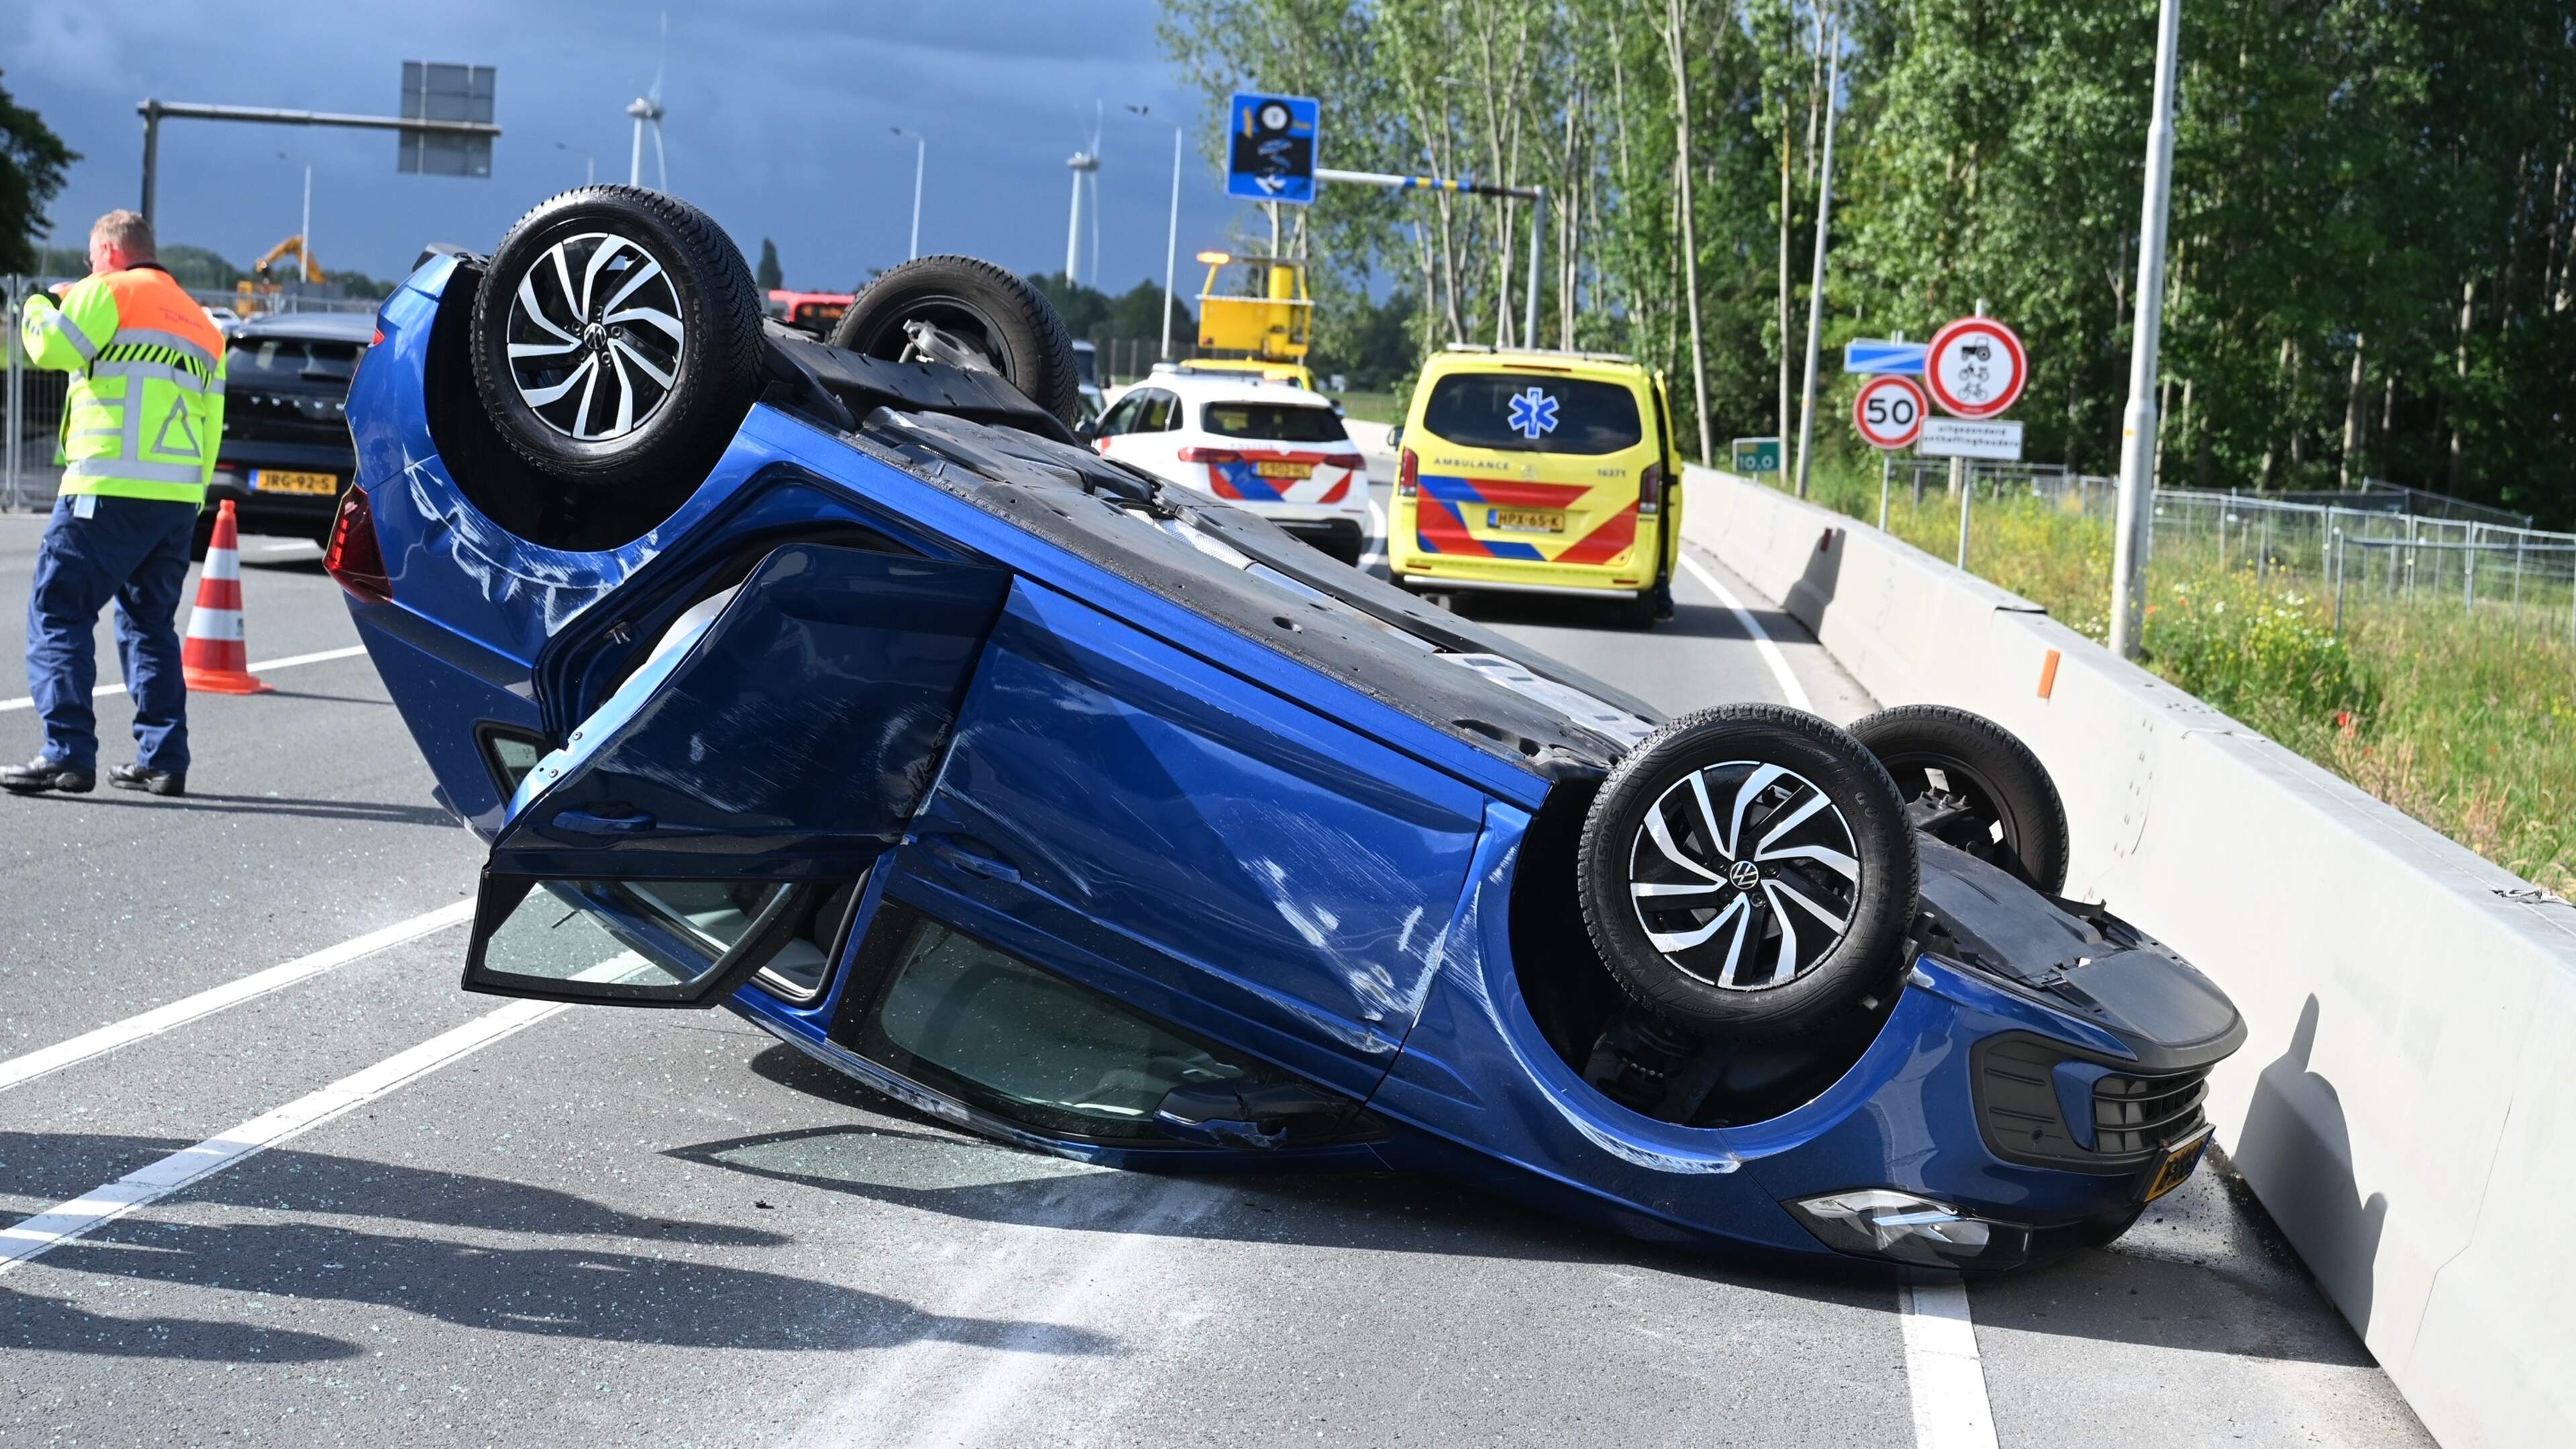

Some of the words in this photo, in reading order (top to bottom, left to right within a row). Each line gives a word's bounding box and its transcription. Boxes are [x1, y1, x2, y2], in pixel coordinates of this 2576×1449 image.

[1868, 398, 1913, 425] 50
[1434, 458, 1509, 470] AMBULANCE
[1739, 455, 1774, 470] 10.0
[263, 473, 329, 490] JRG-92-S
[1855, 791, 1892, 921] GOODYEAR
